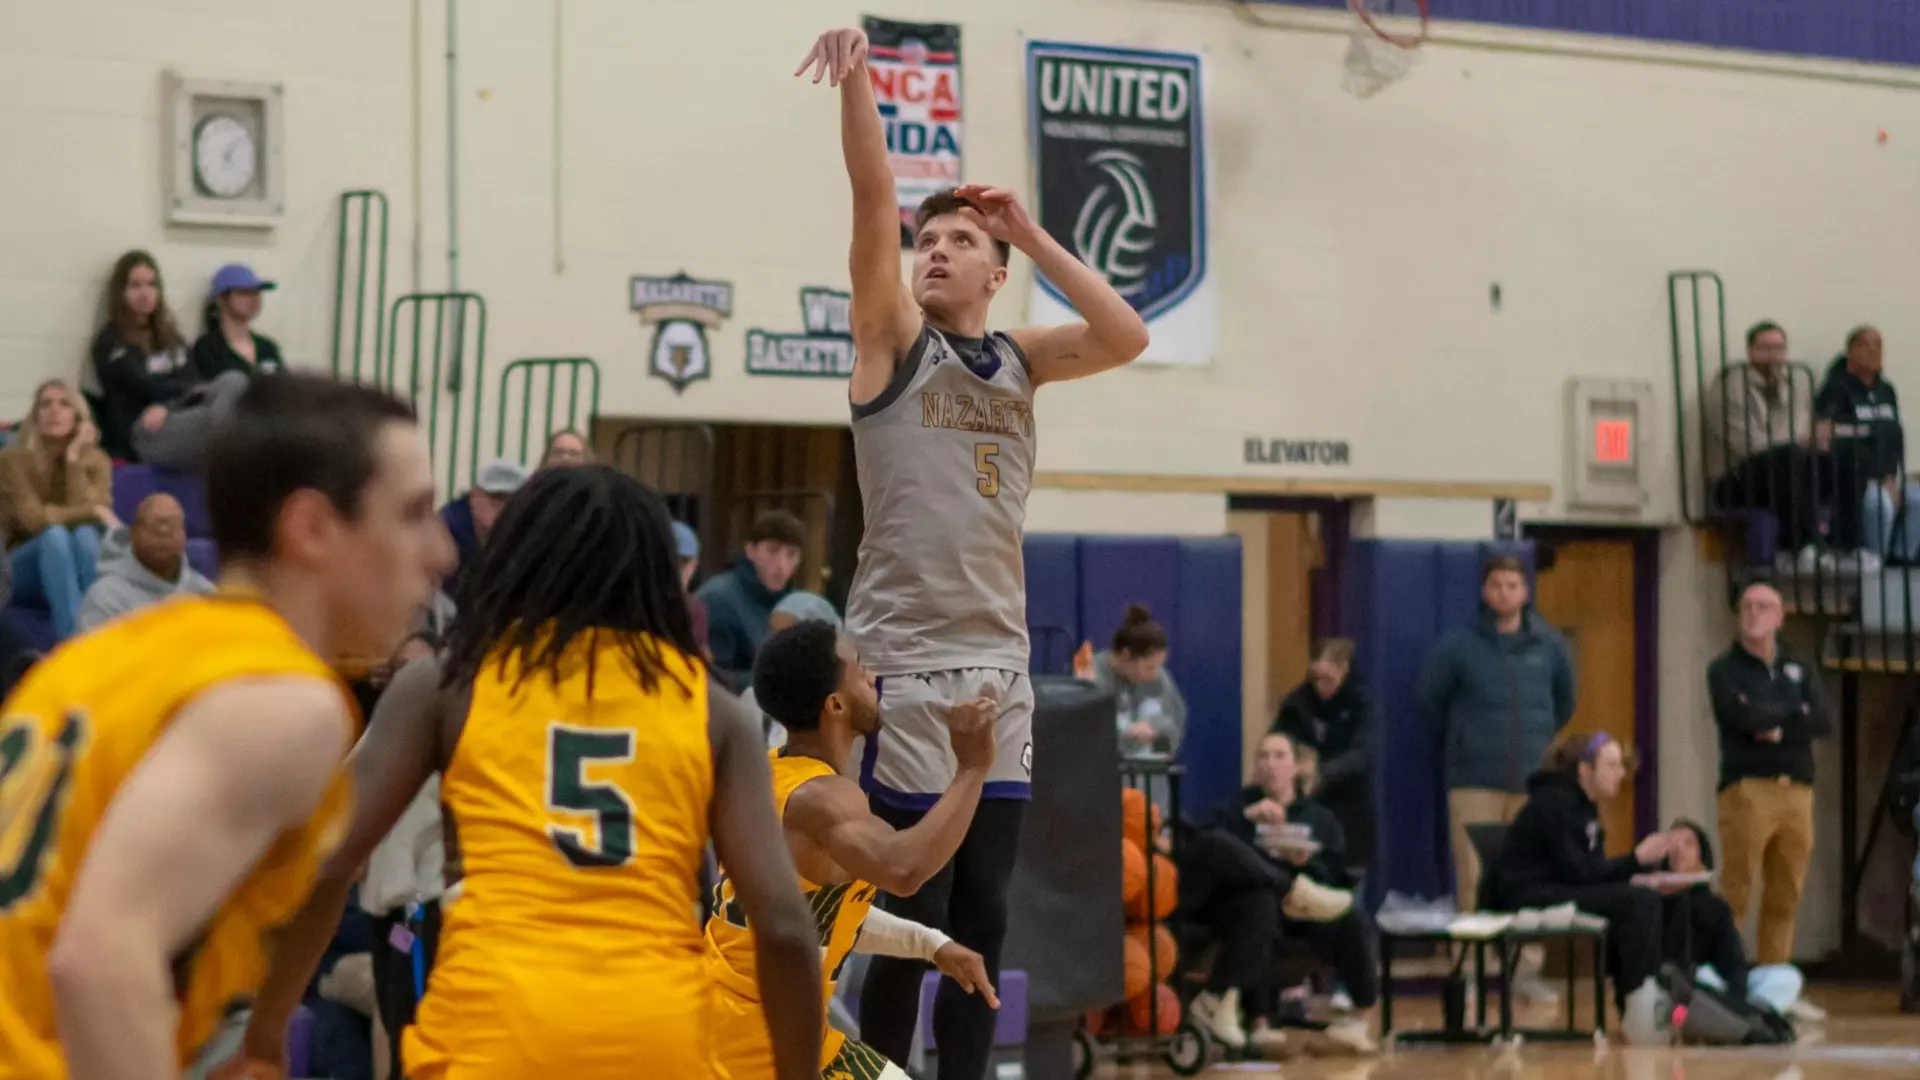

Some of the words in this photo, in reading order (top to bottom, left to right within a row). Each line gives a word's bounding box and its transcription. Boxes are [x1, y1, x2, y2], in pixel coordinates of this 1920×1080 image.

[868, 65, 958, 104] NCA
[1041, 61, 1188, 121] UNITED
[976, 442, 999, 498] 5
[1244, 438, 1349, 466] ELEVATOR
[546, 722, 637, 870] 5
